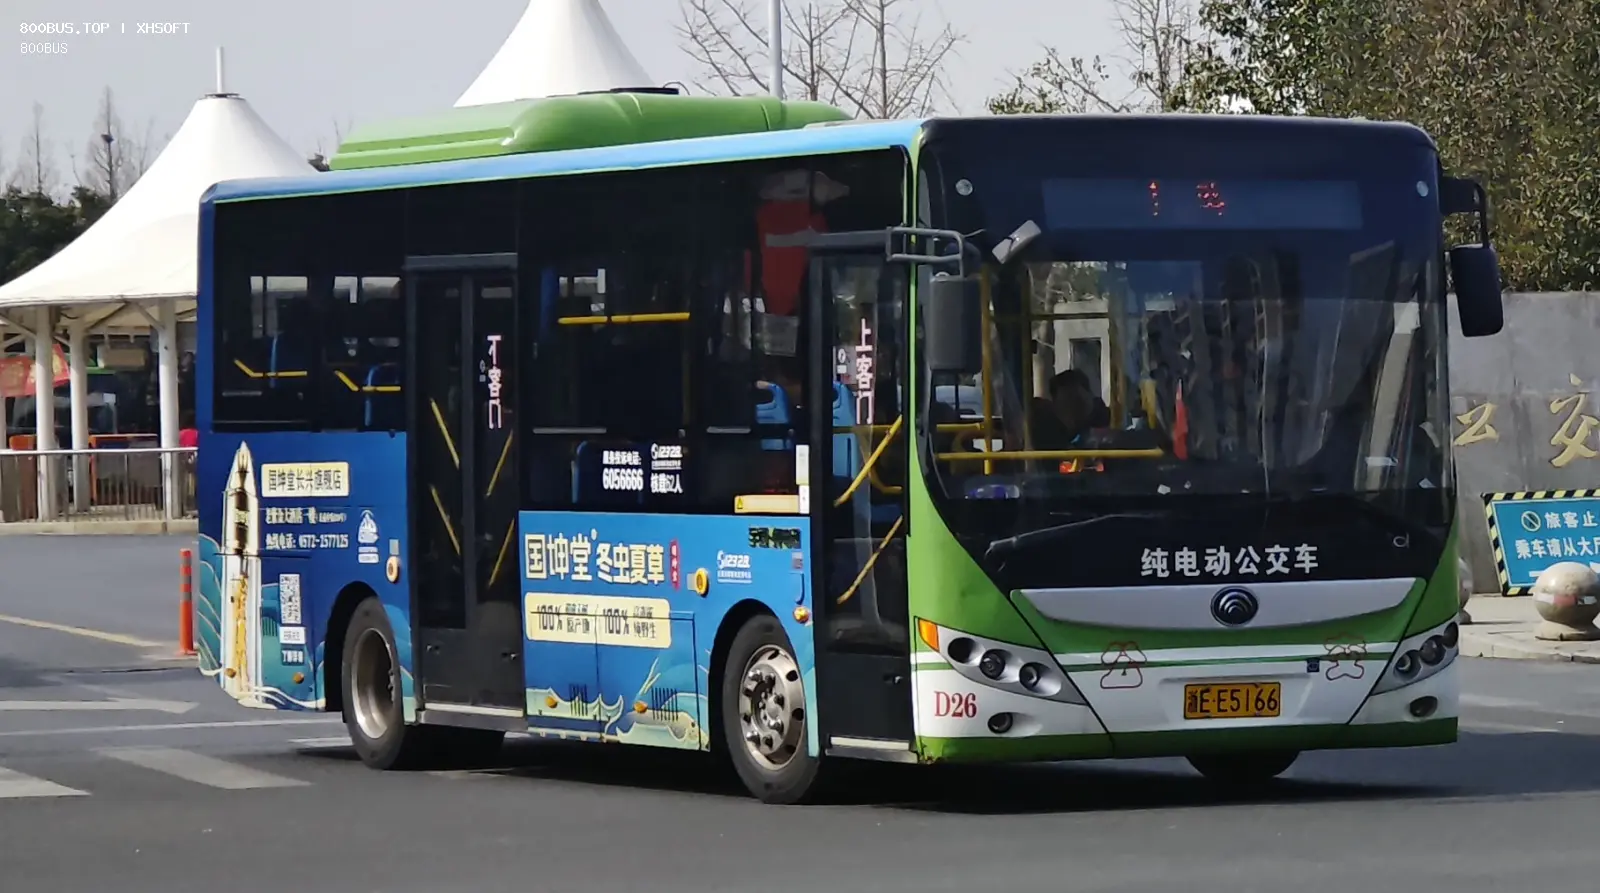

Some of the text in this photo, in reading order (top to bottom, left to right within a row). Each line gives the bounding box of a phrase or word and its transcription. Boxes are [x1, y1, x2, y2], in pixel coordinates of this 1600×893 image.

[855, 318, 873, 425] 上客门
[602, 467, 643, 491] 6056666
[525, 532, 592, 580] 国坤堂
[596, 542, 664, 585] 冬虫夏草
[1140, 543, 1318, 578] 纯电动公交车
[933, 690, 977, 718] D26
